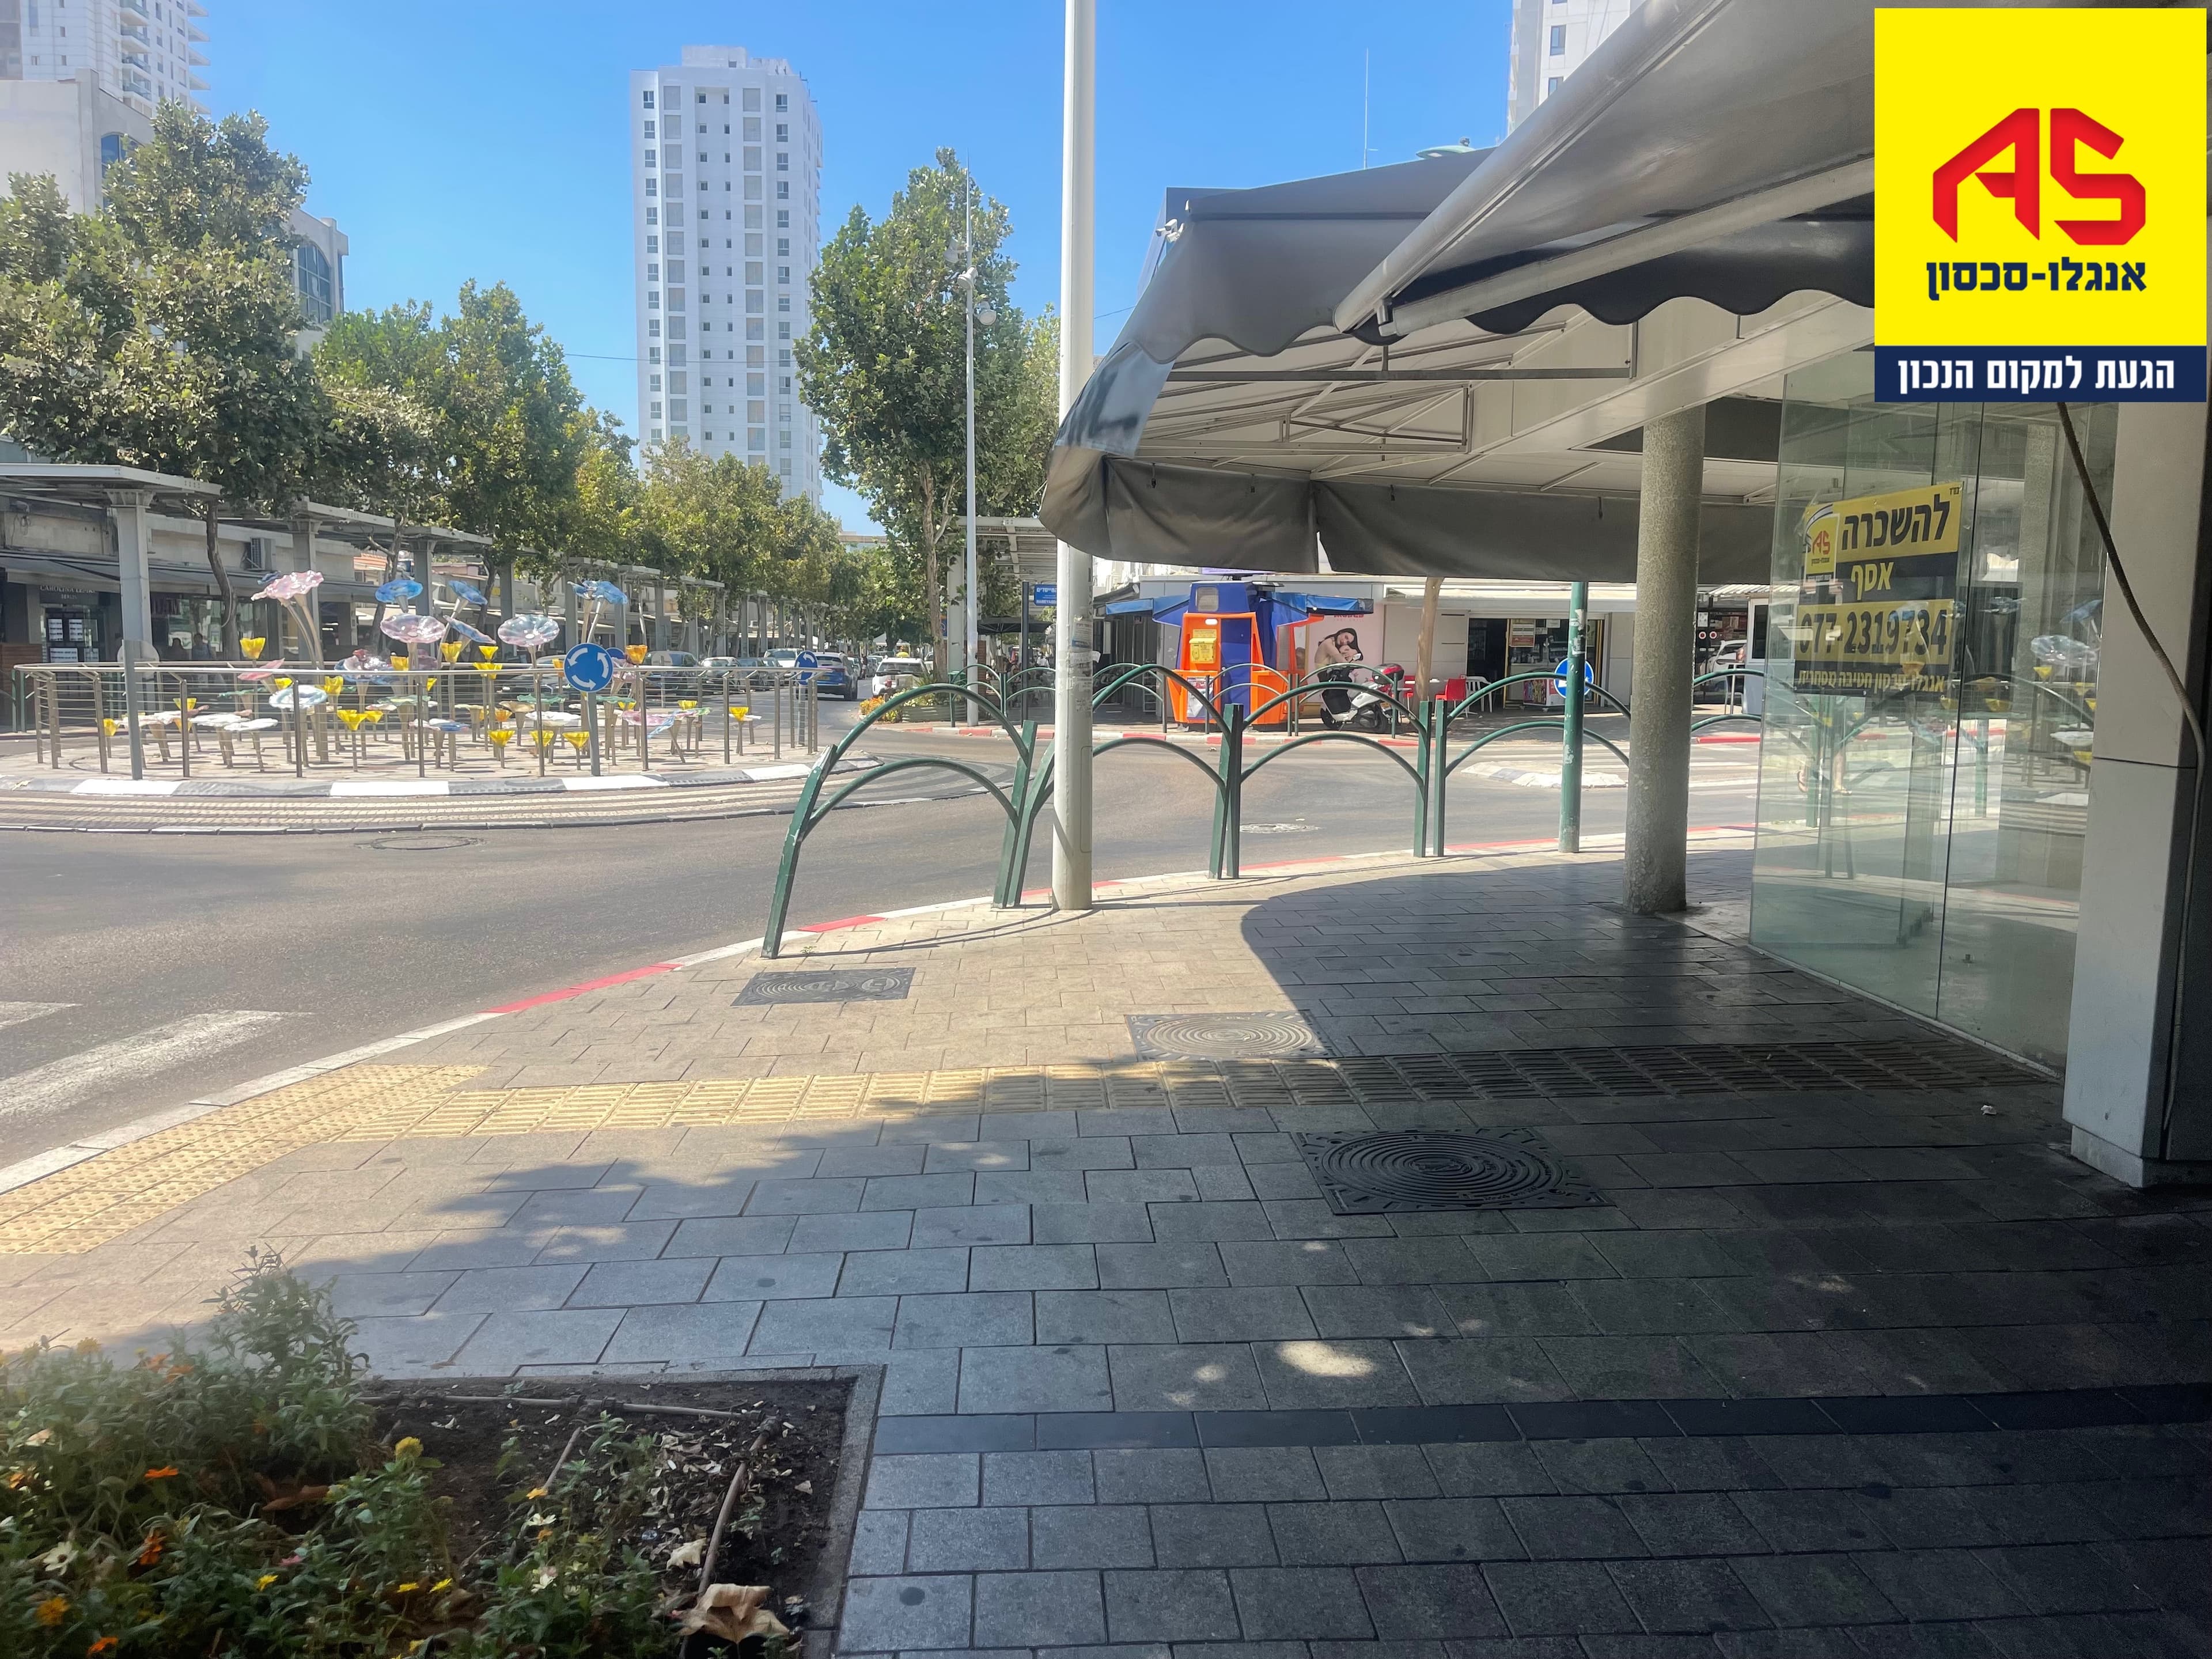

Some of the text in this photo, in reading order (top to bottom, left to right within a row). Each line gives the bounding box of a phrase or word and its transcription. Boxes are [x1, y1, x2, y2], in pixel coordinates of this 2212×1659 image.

[1842, 494, 1950, 550] להשכרה
[1851, 562, 1894, 601] אסף
[1838, 672, 1872, 688] חטיבה
